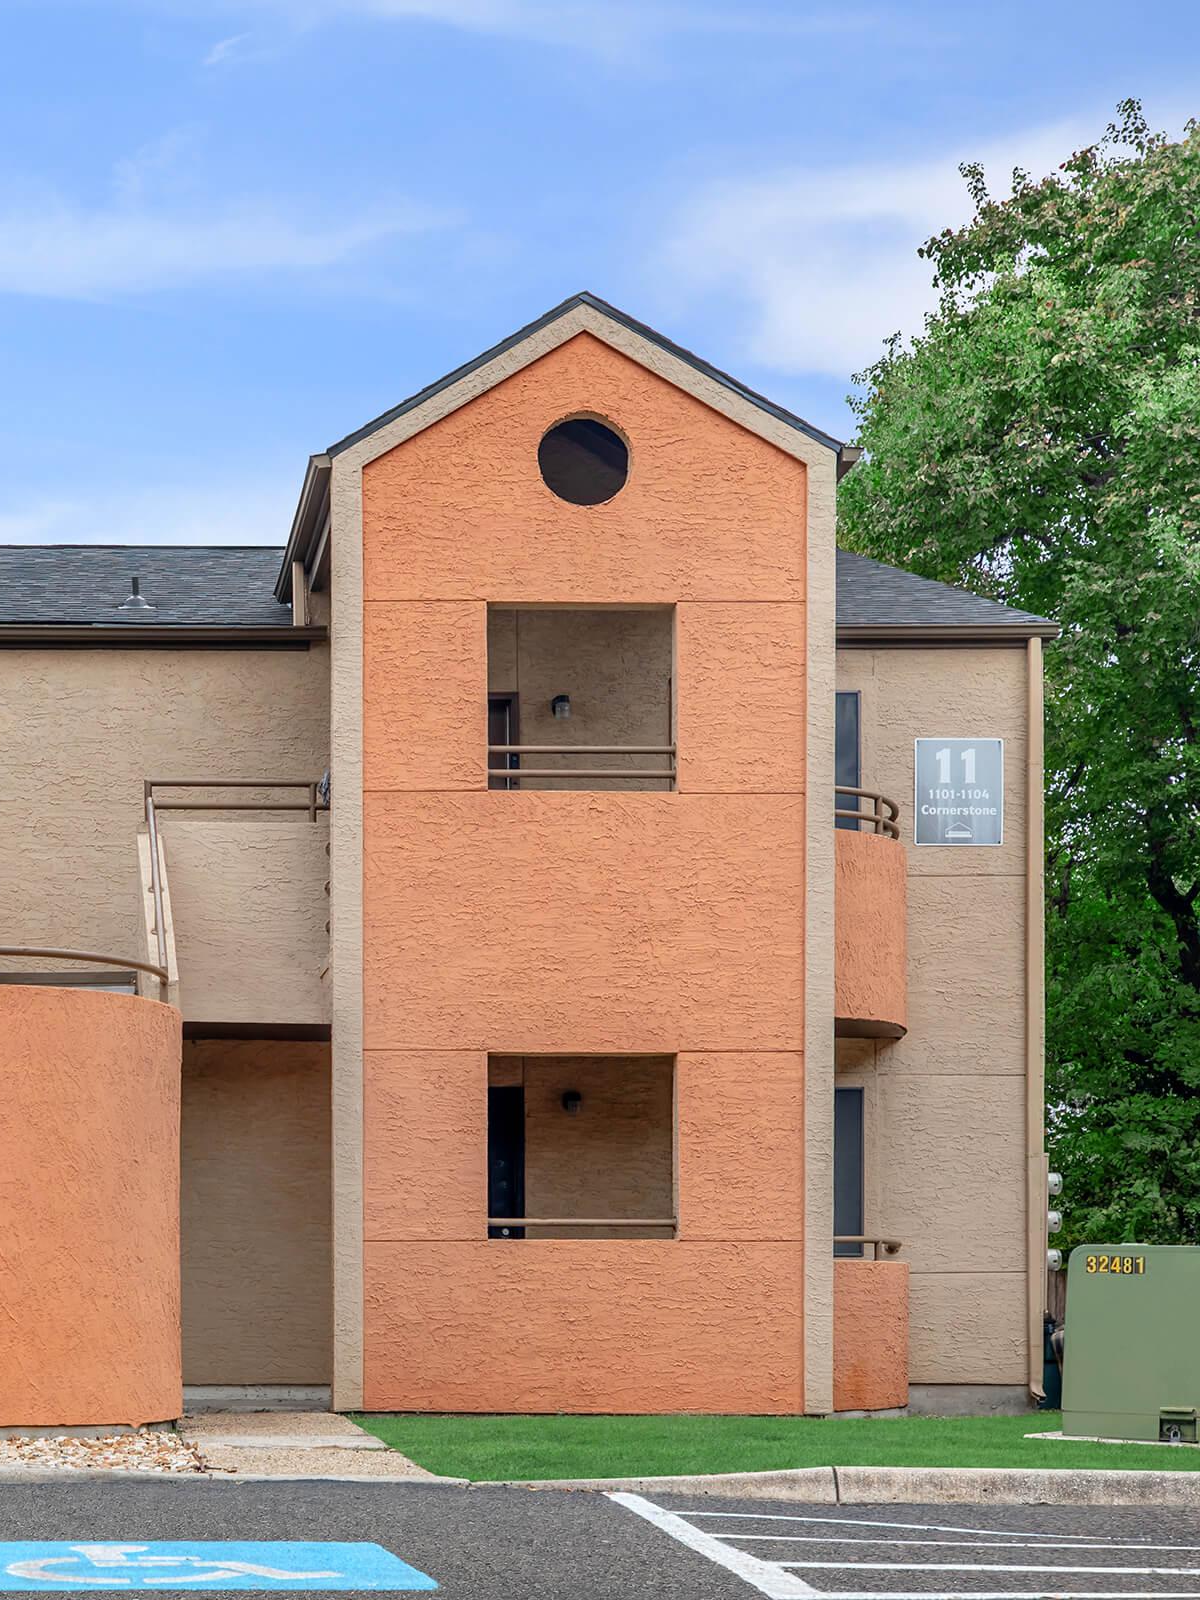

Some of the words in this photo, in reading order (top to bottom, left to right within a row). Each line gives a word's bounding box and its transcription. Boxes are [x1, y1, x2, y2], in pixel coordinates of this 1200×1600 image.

[935, 748, 976, 784] 11
[929, 789, 989, 799] 1101-1104
[921, 804, 997, 816] Cornerstone
[1087, 1256, 1145, 1274] 32481
